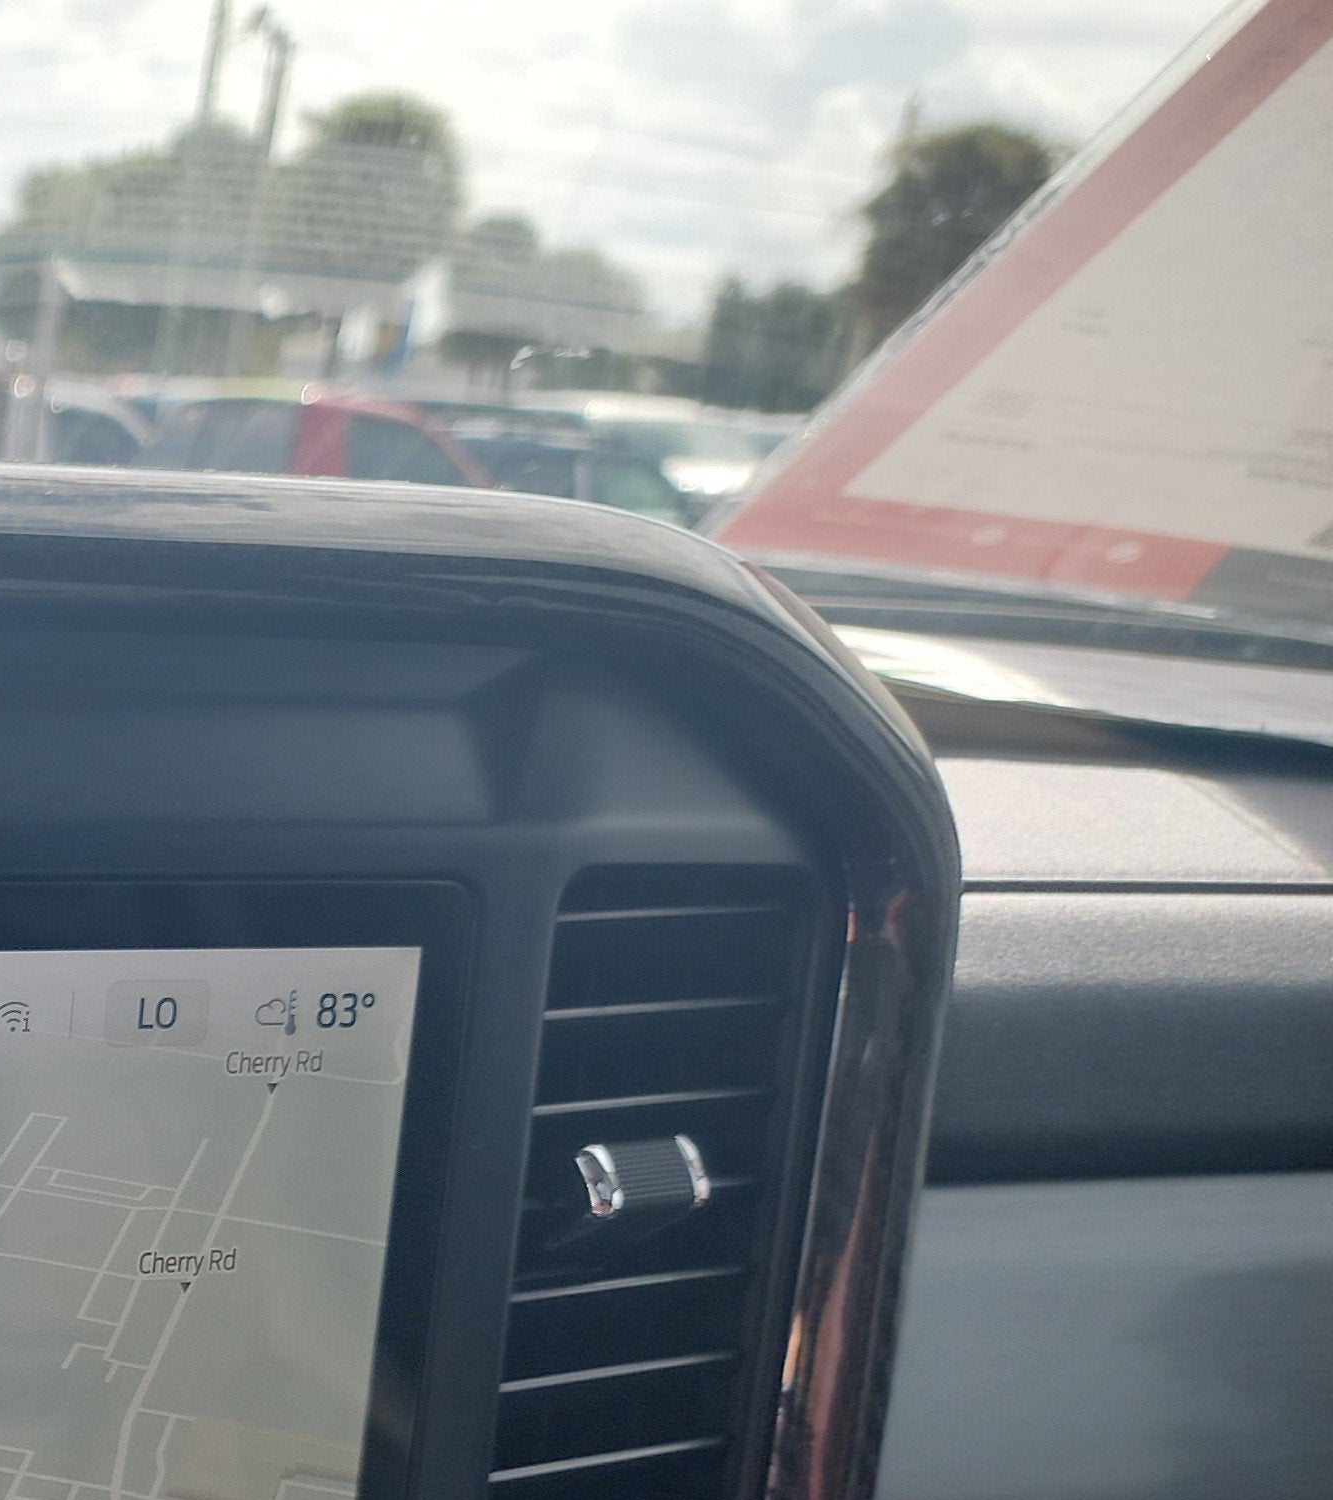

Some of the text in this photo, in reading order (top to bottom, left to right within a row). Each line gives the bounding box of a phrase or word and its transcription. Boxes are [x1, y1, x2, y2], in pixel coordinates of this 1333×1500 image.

[136, 996, 178, 1030] LO
[315, 991, 375, 1030] 83°
[225, 1049, 323, 1078] Cherry Rd
[138, 1248, 238, 1276] Cherry Rd
